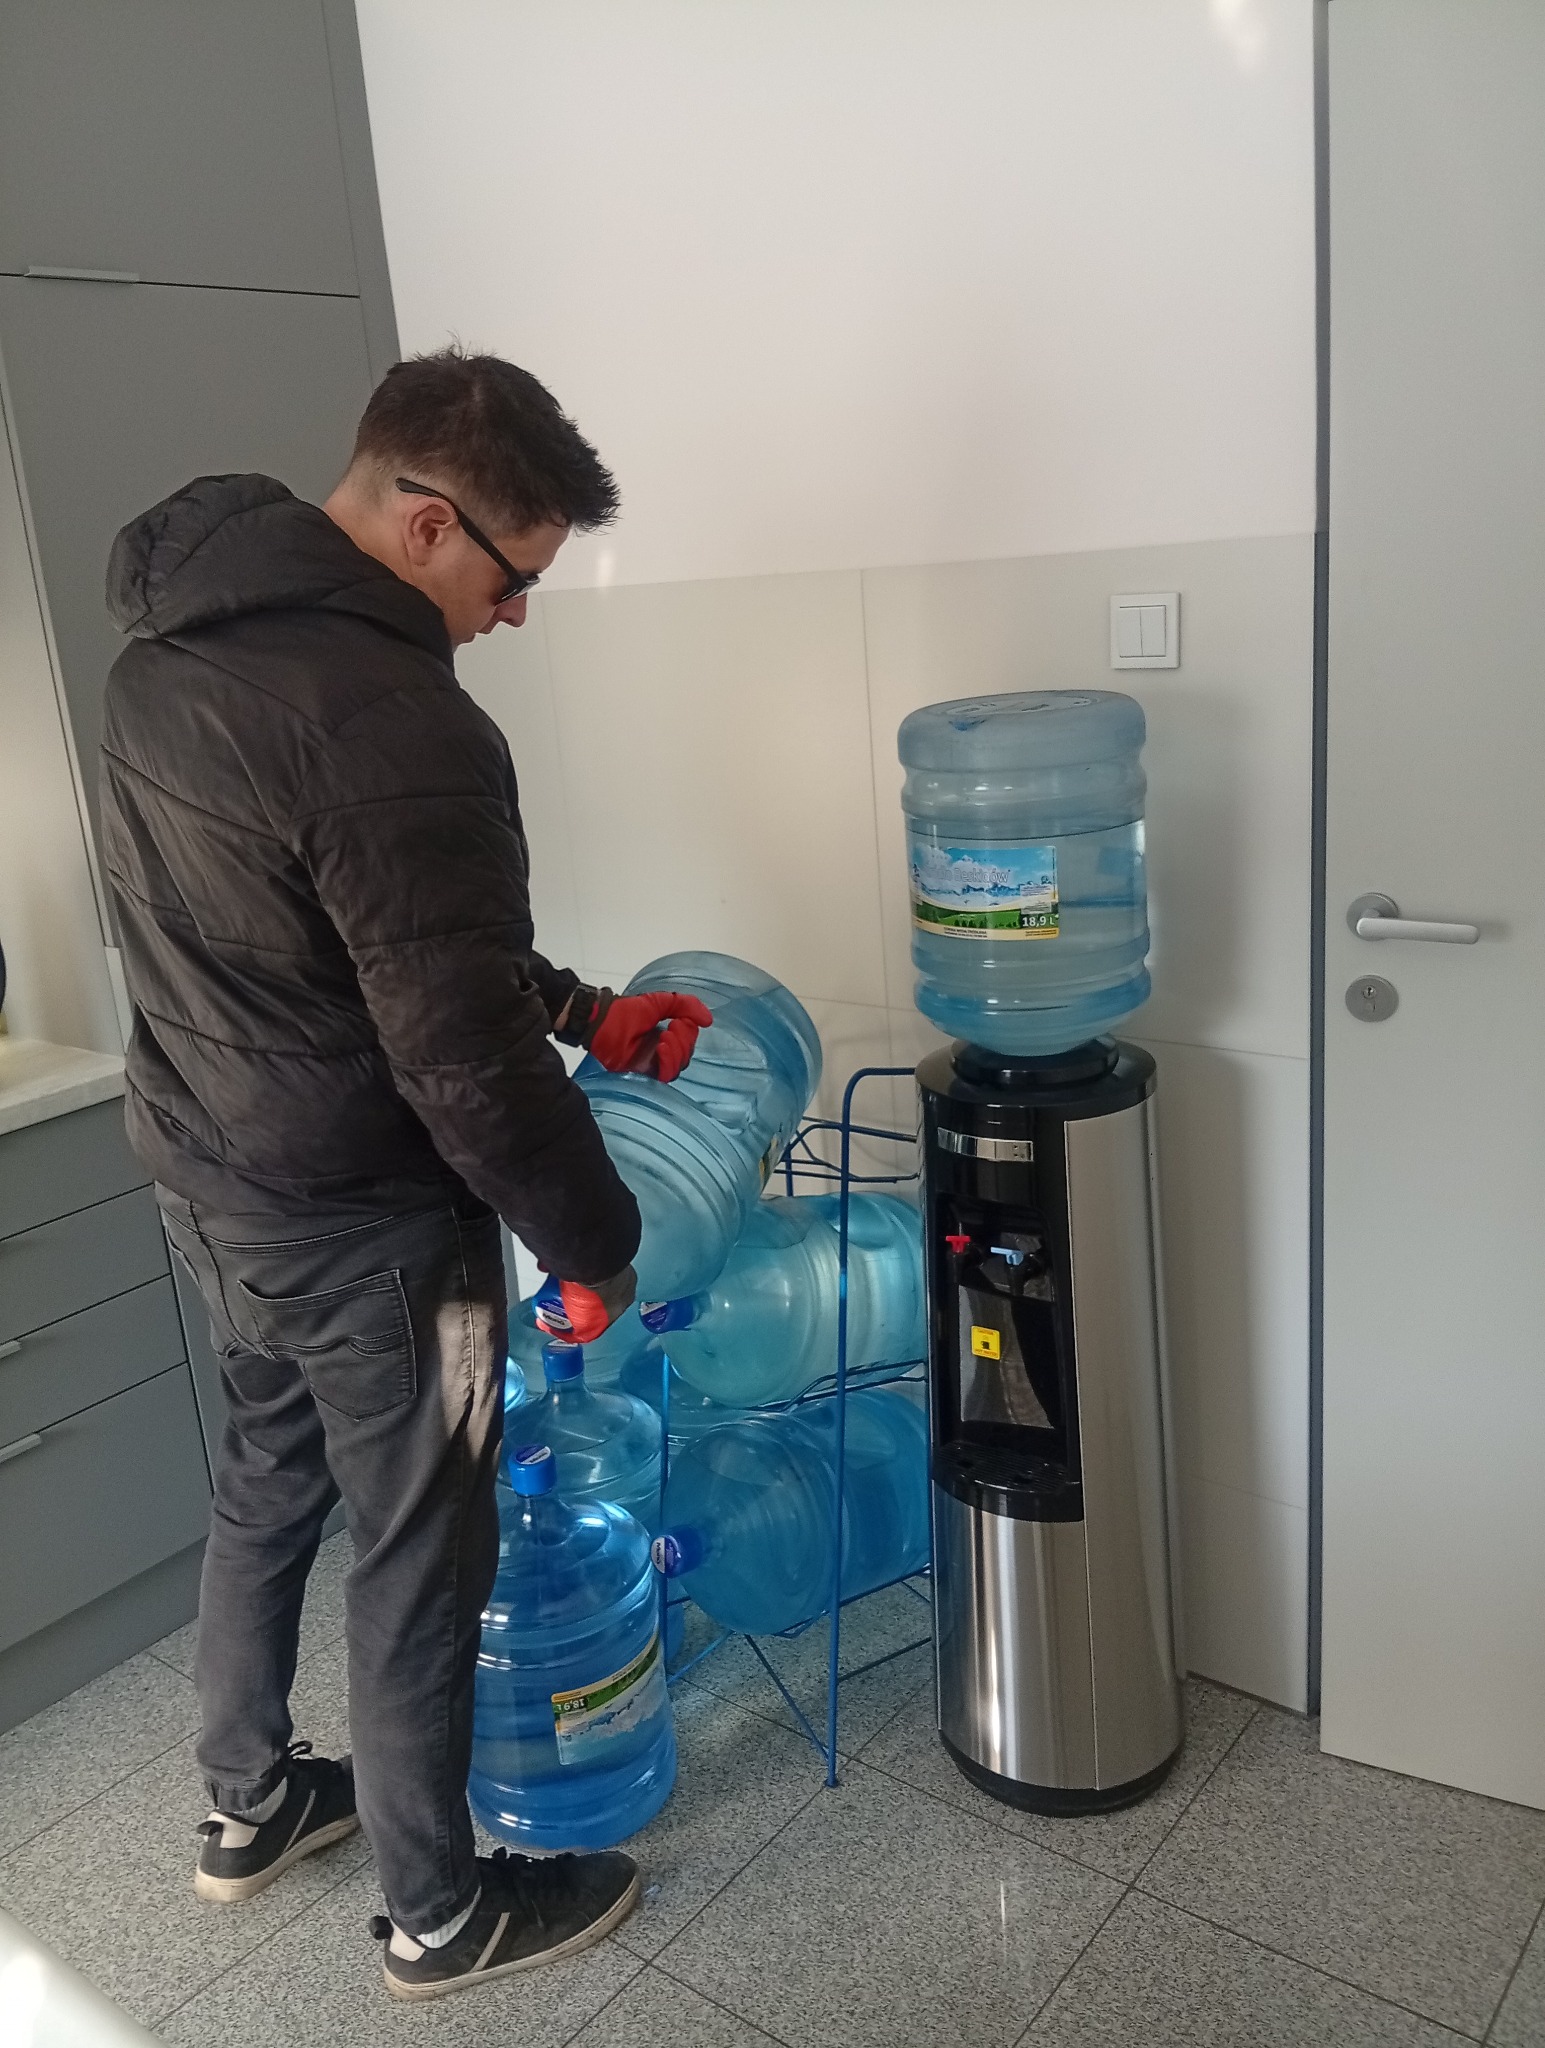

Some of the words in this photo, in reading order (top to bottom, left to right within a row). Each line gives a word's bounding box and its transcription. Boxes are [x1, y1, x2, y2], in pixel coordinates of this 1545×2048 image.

[1022, 915, 1046, 928] 18,9
[1049, 916, 1055, 925] L
[564, 1698, 585, 1711] 18,9
